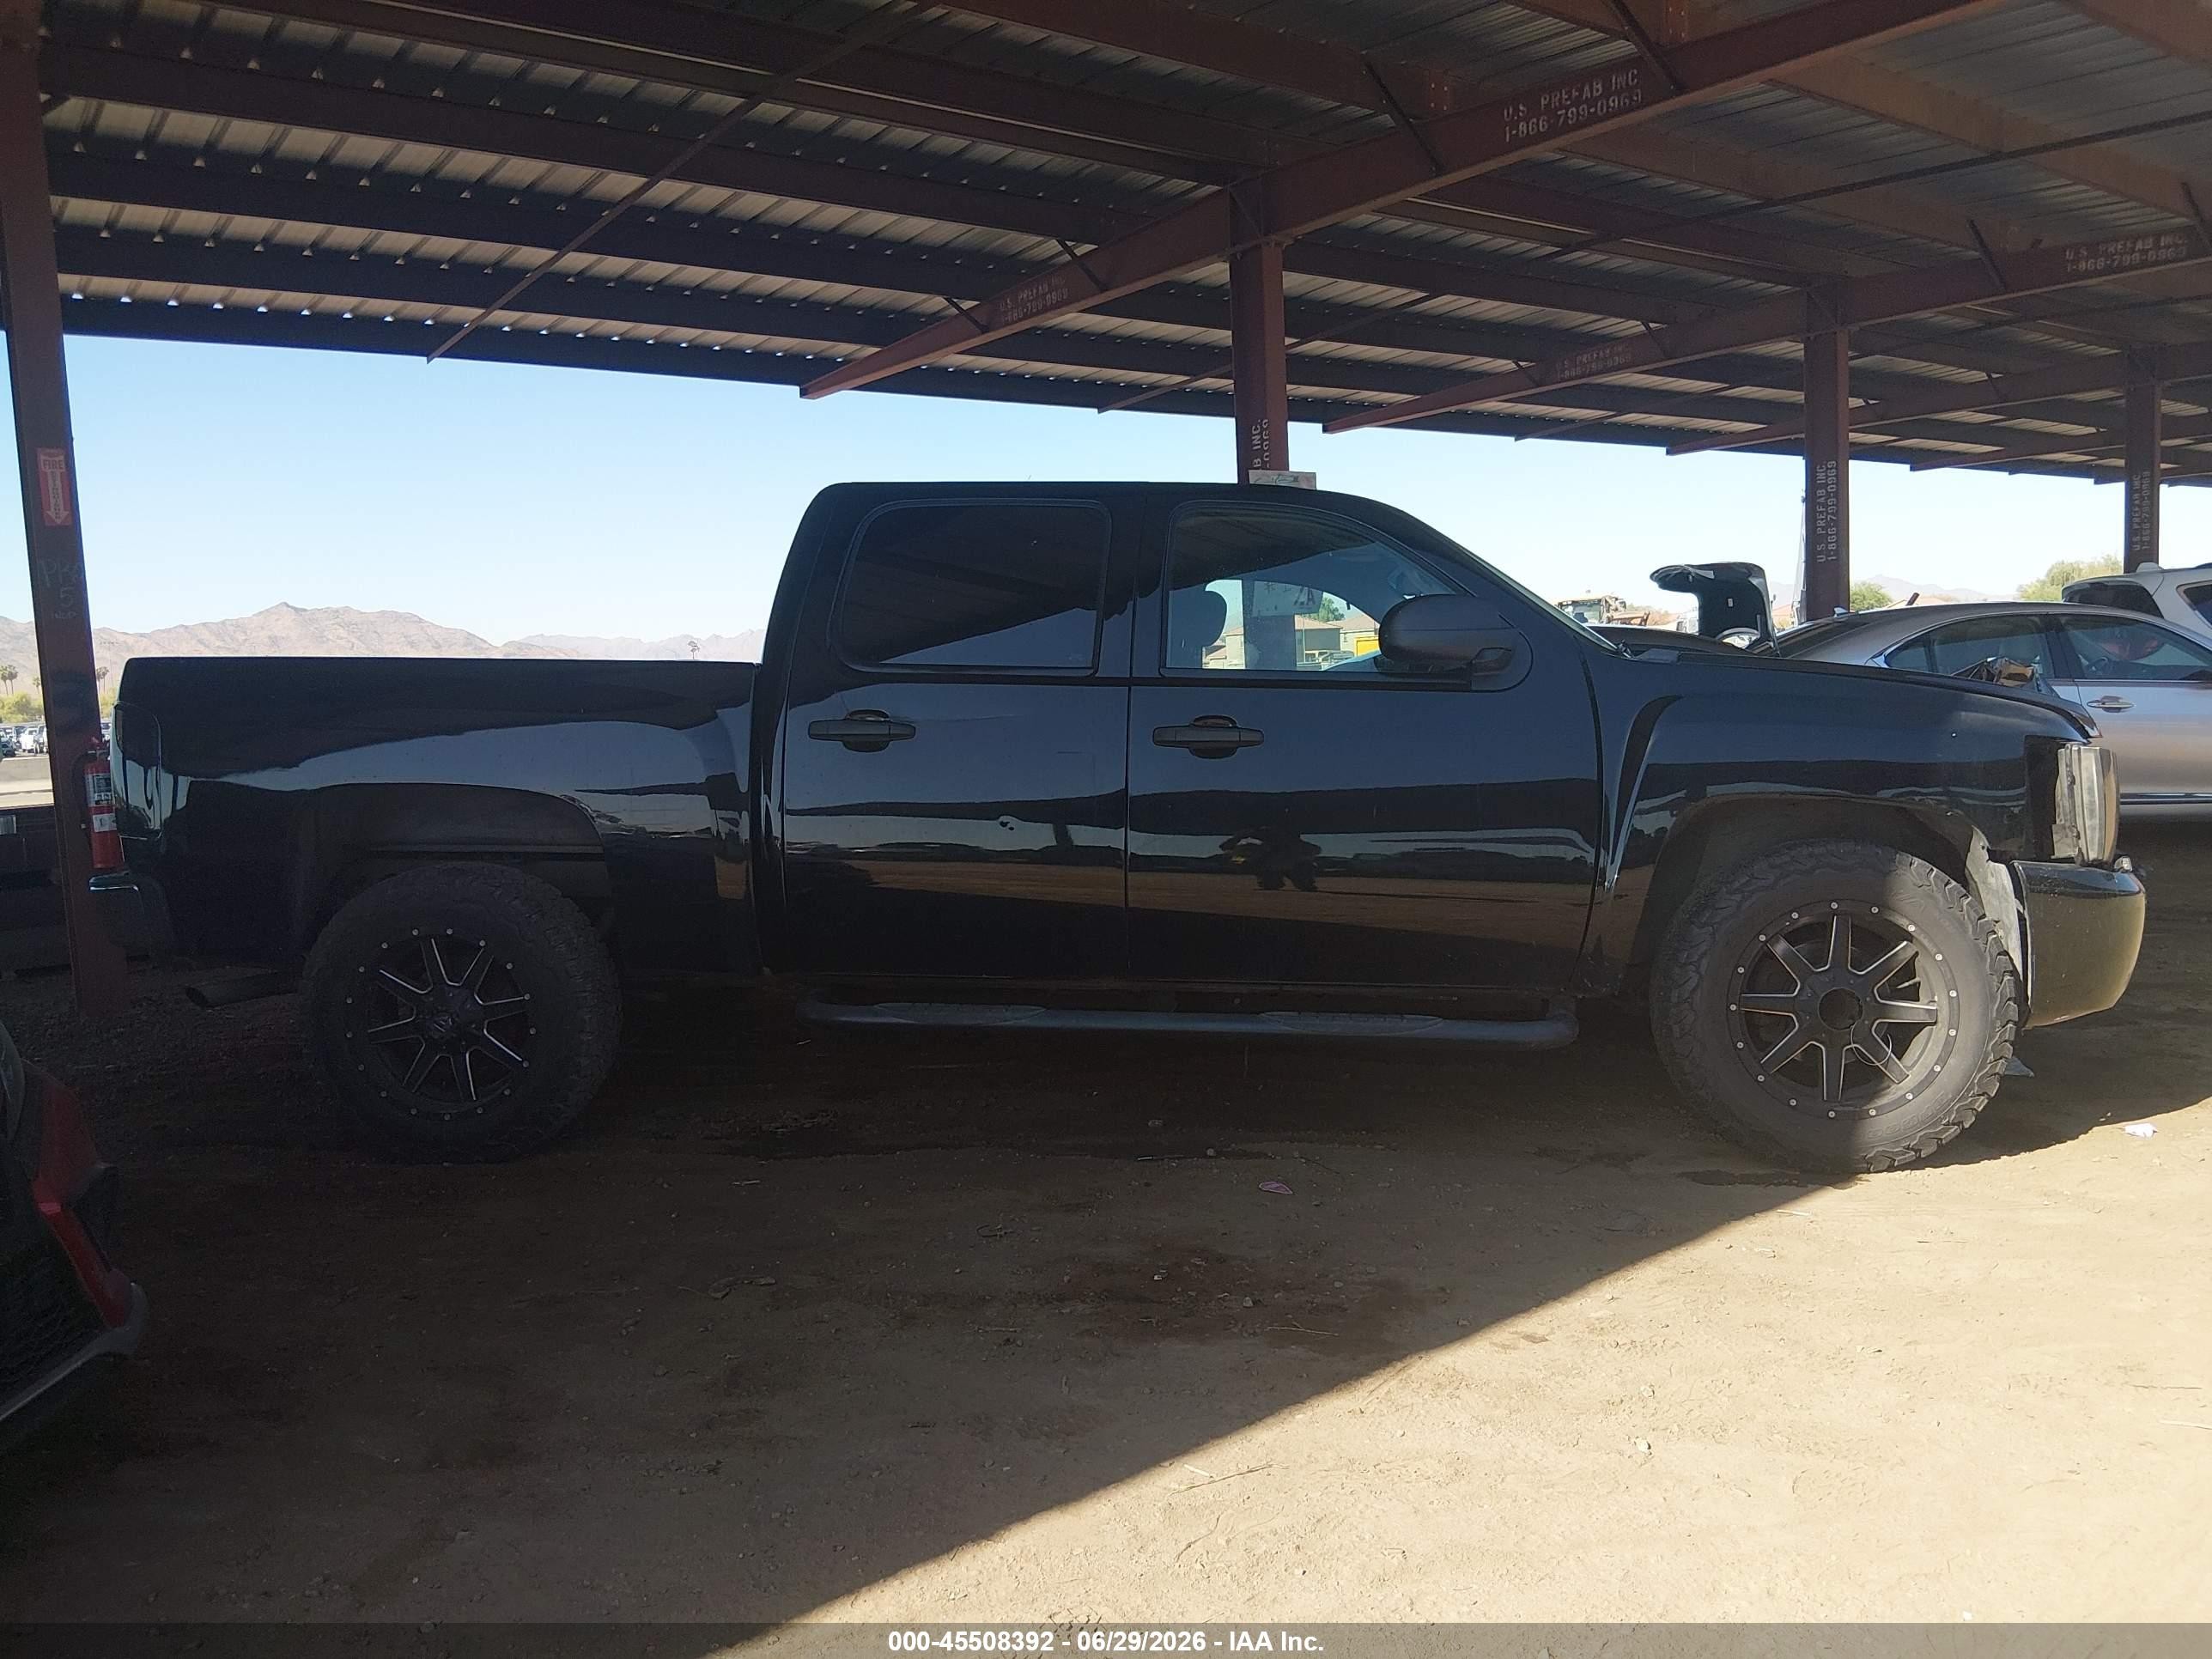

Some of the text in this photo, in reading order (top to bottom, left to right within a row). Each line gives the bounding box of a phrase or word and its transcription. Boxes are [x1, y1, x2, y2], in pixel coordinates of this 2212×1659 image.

[1540, 80, 1603, 111] PREFAB
[43, 459, 64, 470] FIRE
[1816, 489, 1826, 534] PREFAB
[1827, 460, 1837, 561] 1-866-799-0969
